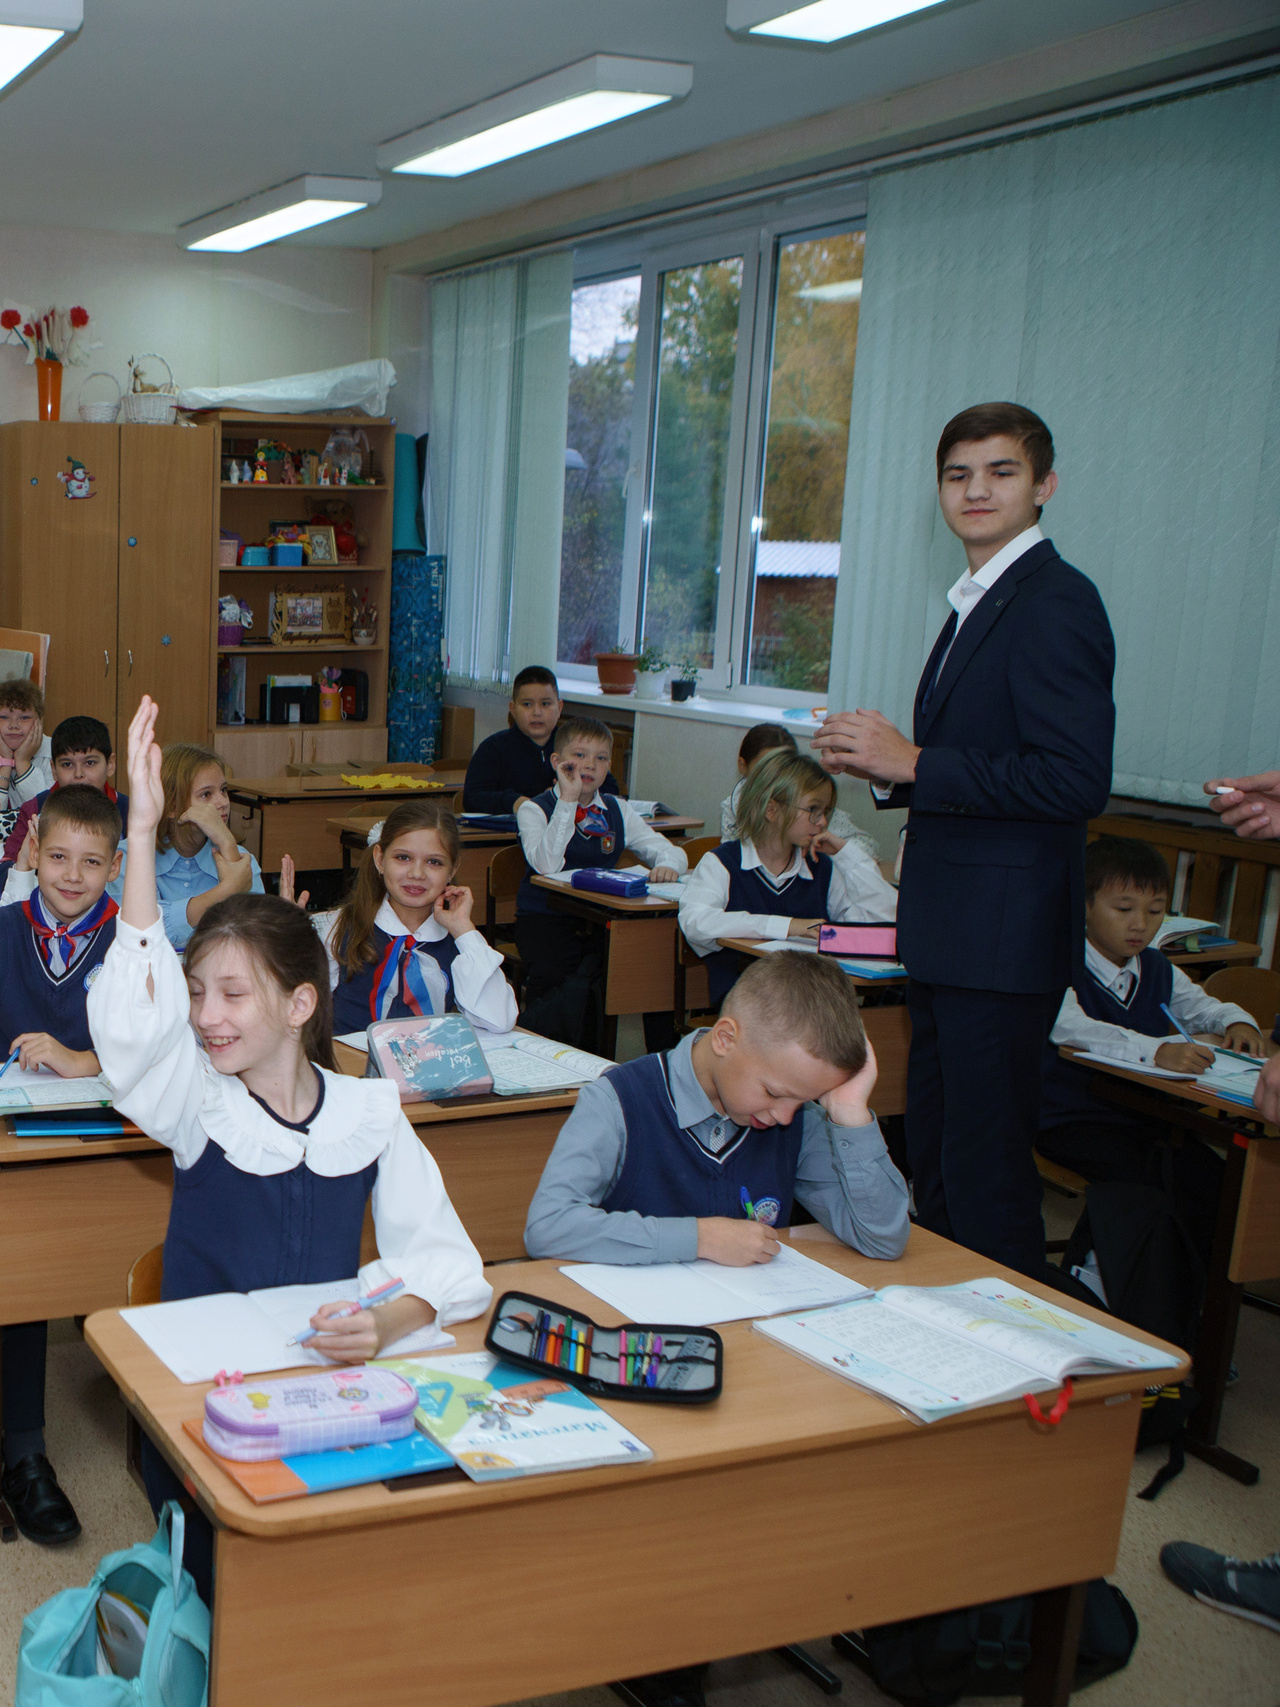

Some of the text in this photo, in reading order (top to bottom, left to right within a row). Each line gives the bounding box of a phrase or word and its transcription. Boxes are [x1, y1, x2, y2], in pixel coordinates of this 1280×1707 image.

[425, 1048, 459, 1062] vacation
[449, 1054, 472, 1069] Best
[468, 1419, 609, 1447] Математика
